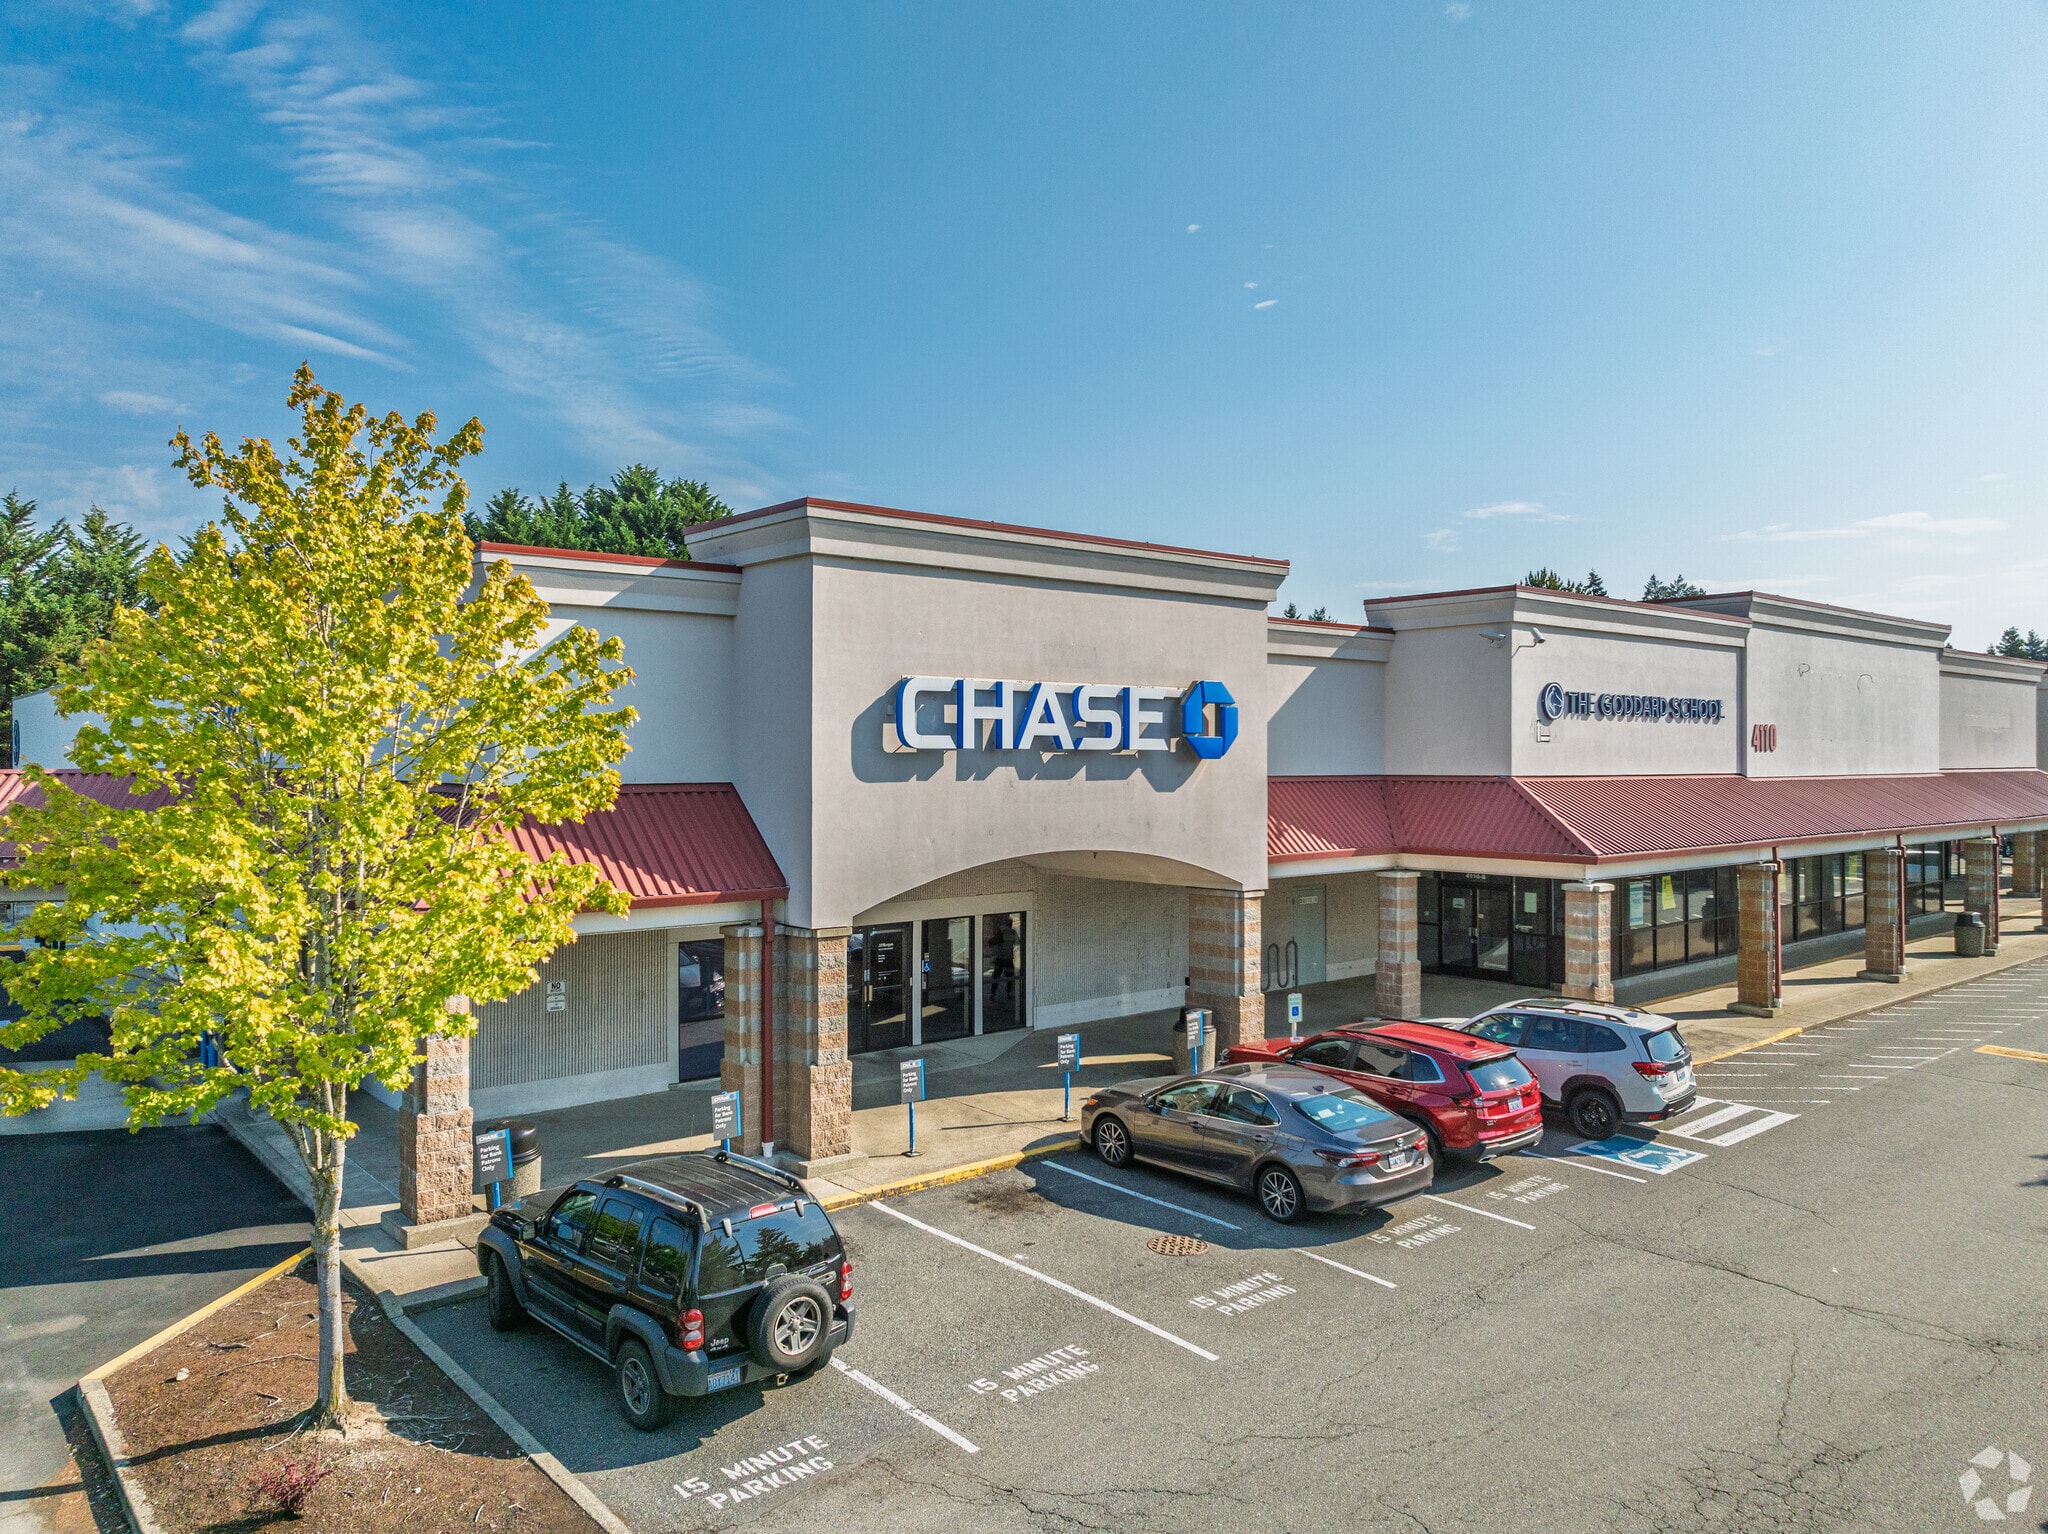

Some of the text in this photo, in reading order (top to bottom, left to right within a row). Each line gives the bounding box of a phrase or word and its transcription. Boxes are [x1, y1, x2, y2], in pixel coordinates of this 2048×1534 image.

[896, 677, 1169, 750] CHASE
[1567, 691, 1726, 720] THE GODDARD SCHOOL
[1752, 724, 1777, 752] 4110
[480, 1145, 500, 1153] Parking
[1486, 1175, 1552, 1200] 15 MINUTE
[1513, 1182, 1570, 1204] PARKING
[1367, 1214, 1443, 1244] 15 MINUTE
[1396, 1223, 1462, 1249] PARKING
[1188, 1271, 1285, 1309] 15 MINUTE
[1216, 1283, 1297, 1317] PARKING
[710, 1337, 730, 1347] Jeep
[968, 1344, 1090, 1395] 15 MINUTE
[1000, 1360, 1099, 1403] PARKING
[673, 1434, 829, 1499] 15 MINUTE
[705, 1456, 834, 1510] PARKING
